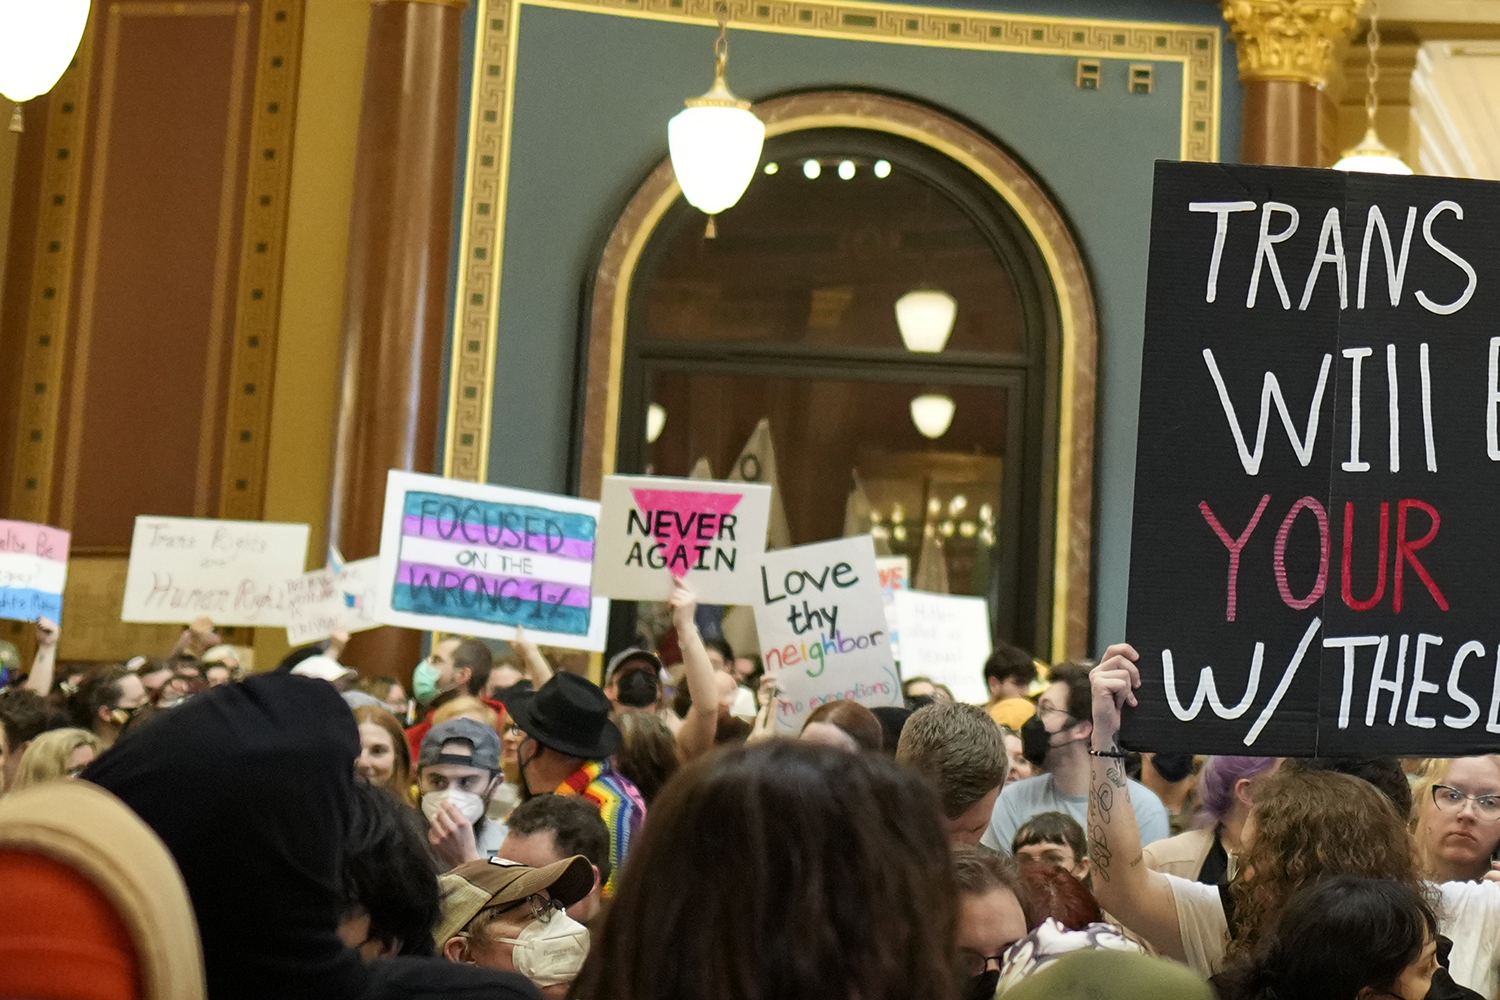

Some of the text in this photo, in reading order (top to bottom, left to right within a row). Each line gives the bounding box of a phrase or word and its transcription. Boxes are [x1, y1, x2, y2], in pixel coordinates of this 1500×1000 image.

[1188, 201, 1478, 315] TRANS
[418, 499, 565, 555] FOCUSED
[626, 508, 738, 542] NEVER
[455, 549, 534, 575] ON THE
[624, 541, 738, 573] AGAIN
[1198, 493, 1451, 623] YOUR
[408, 566, 522, 616] WRONG
[760, 561, 860, 606] Love
[786, 600, 839, 640] thy
[765, 629, 884, 678] neighbor
